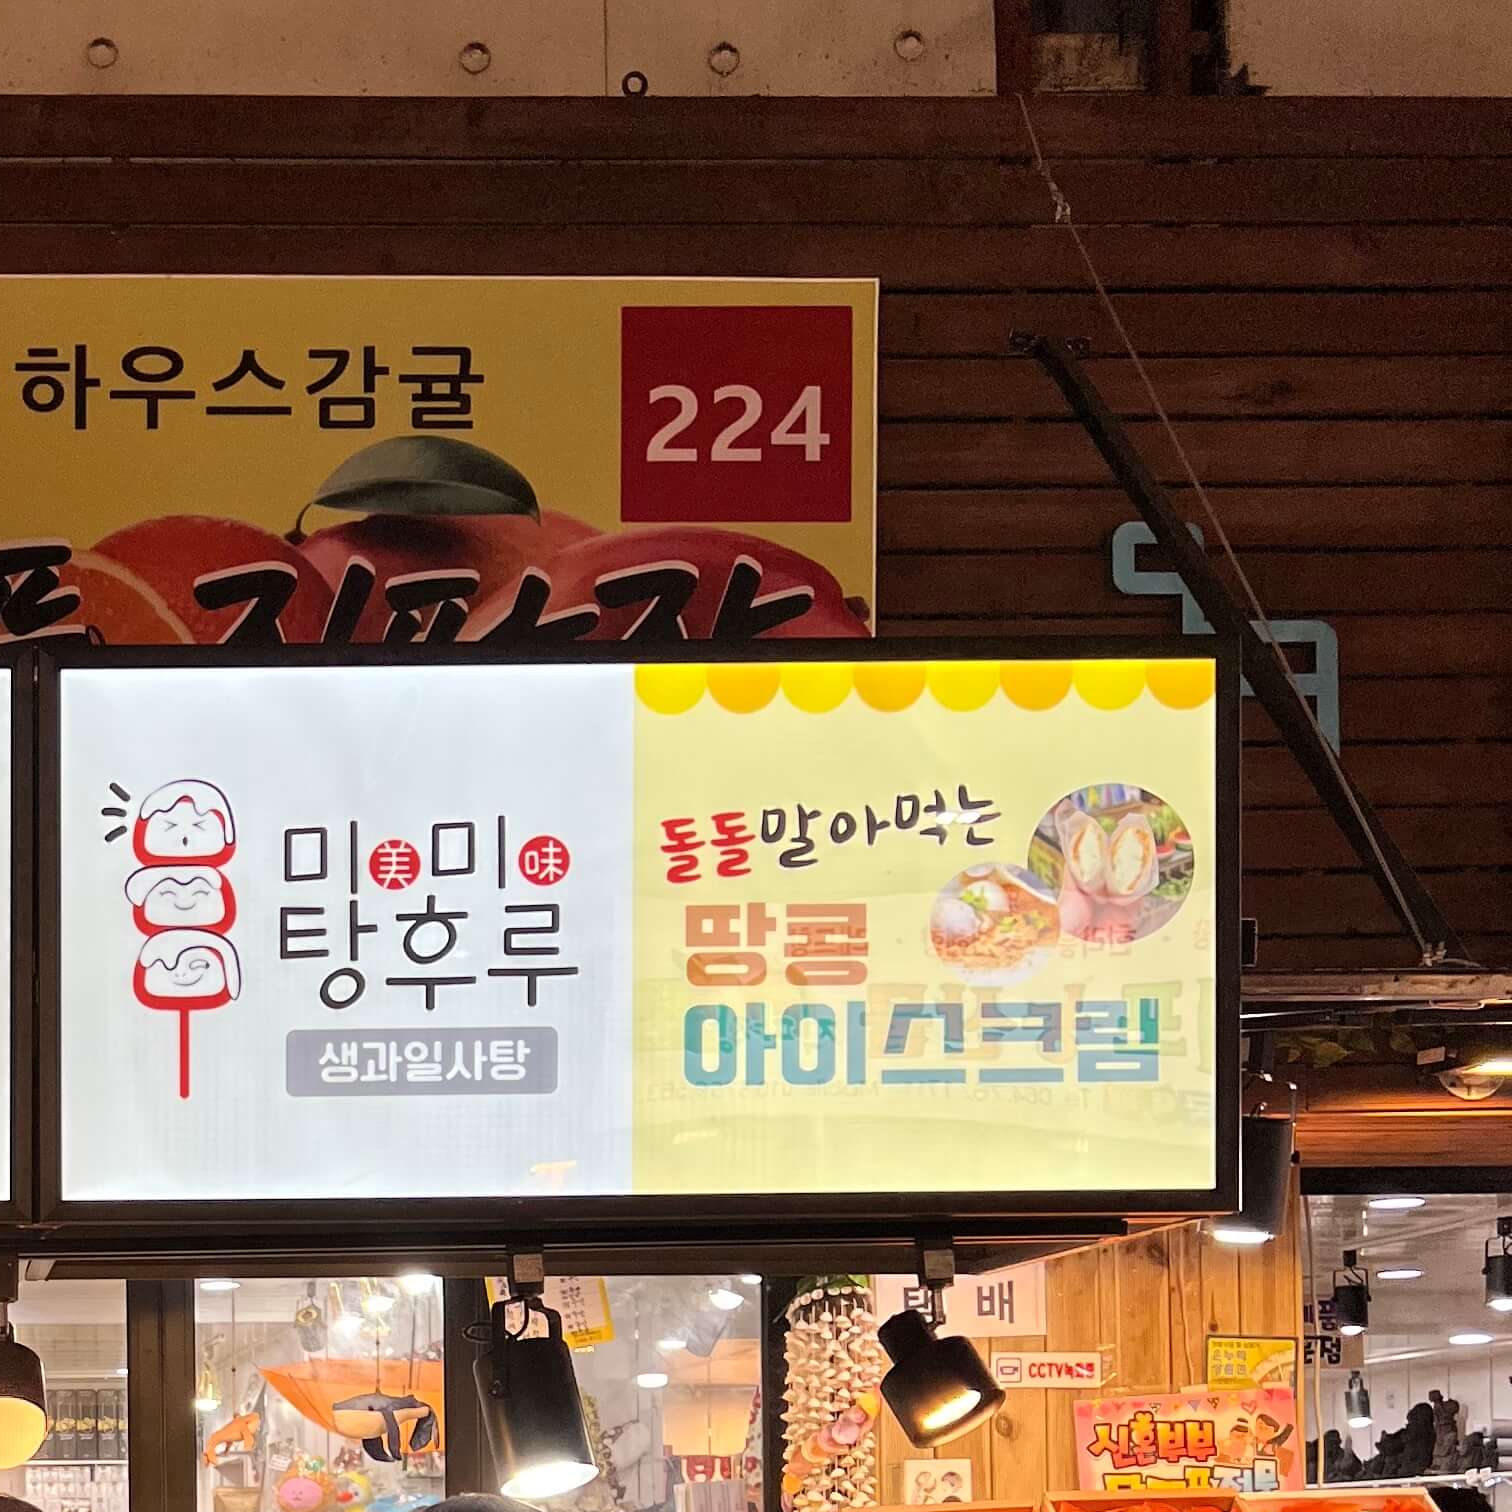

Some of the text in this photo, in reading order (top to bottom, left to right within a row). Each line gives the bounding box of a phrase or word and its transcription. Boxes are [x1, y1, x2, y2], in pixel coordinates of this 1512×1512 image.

[14, 343, 487, 432] 하우스감귤
[645, 384, 831, 464] 224
[279, 894, 579, 1011] 탕후루
[685, 902, 869, 987] 땅콩
[319, 1039, 531, 1083] 생과일사탕
[683, 999, 1160, 1087] 아이스크림
[1087, 1410, 1218, 1470] 신혼부부
